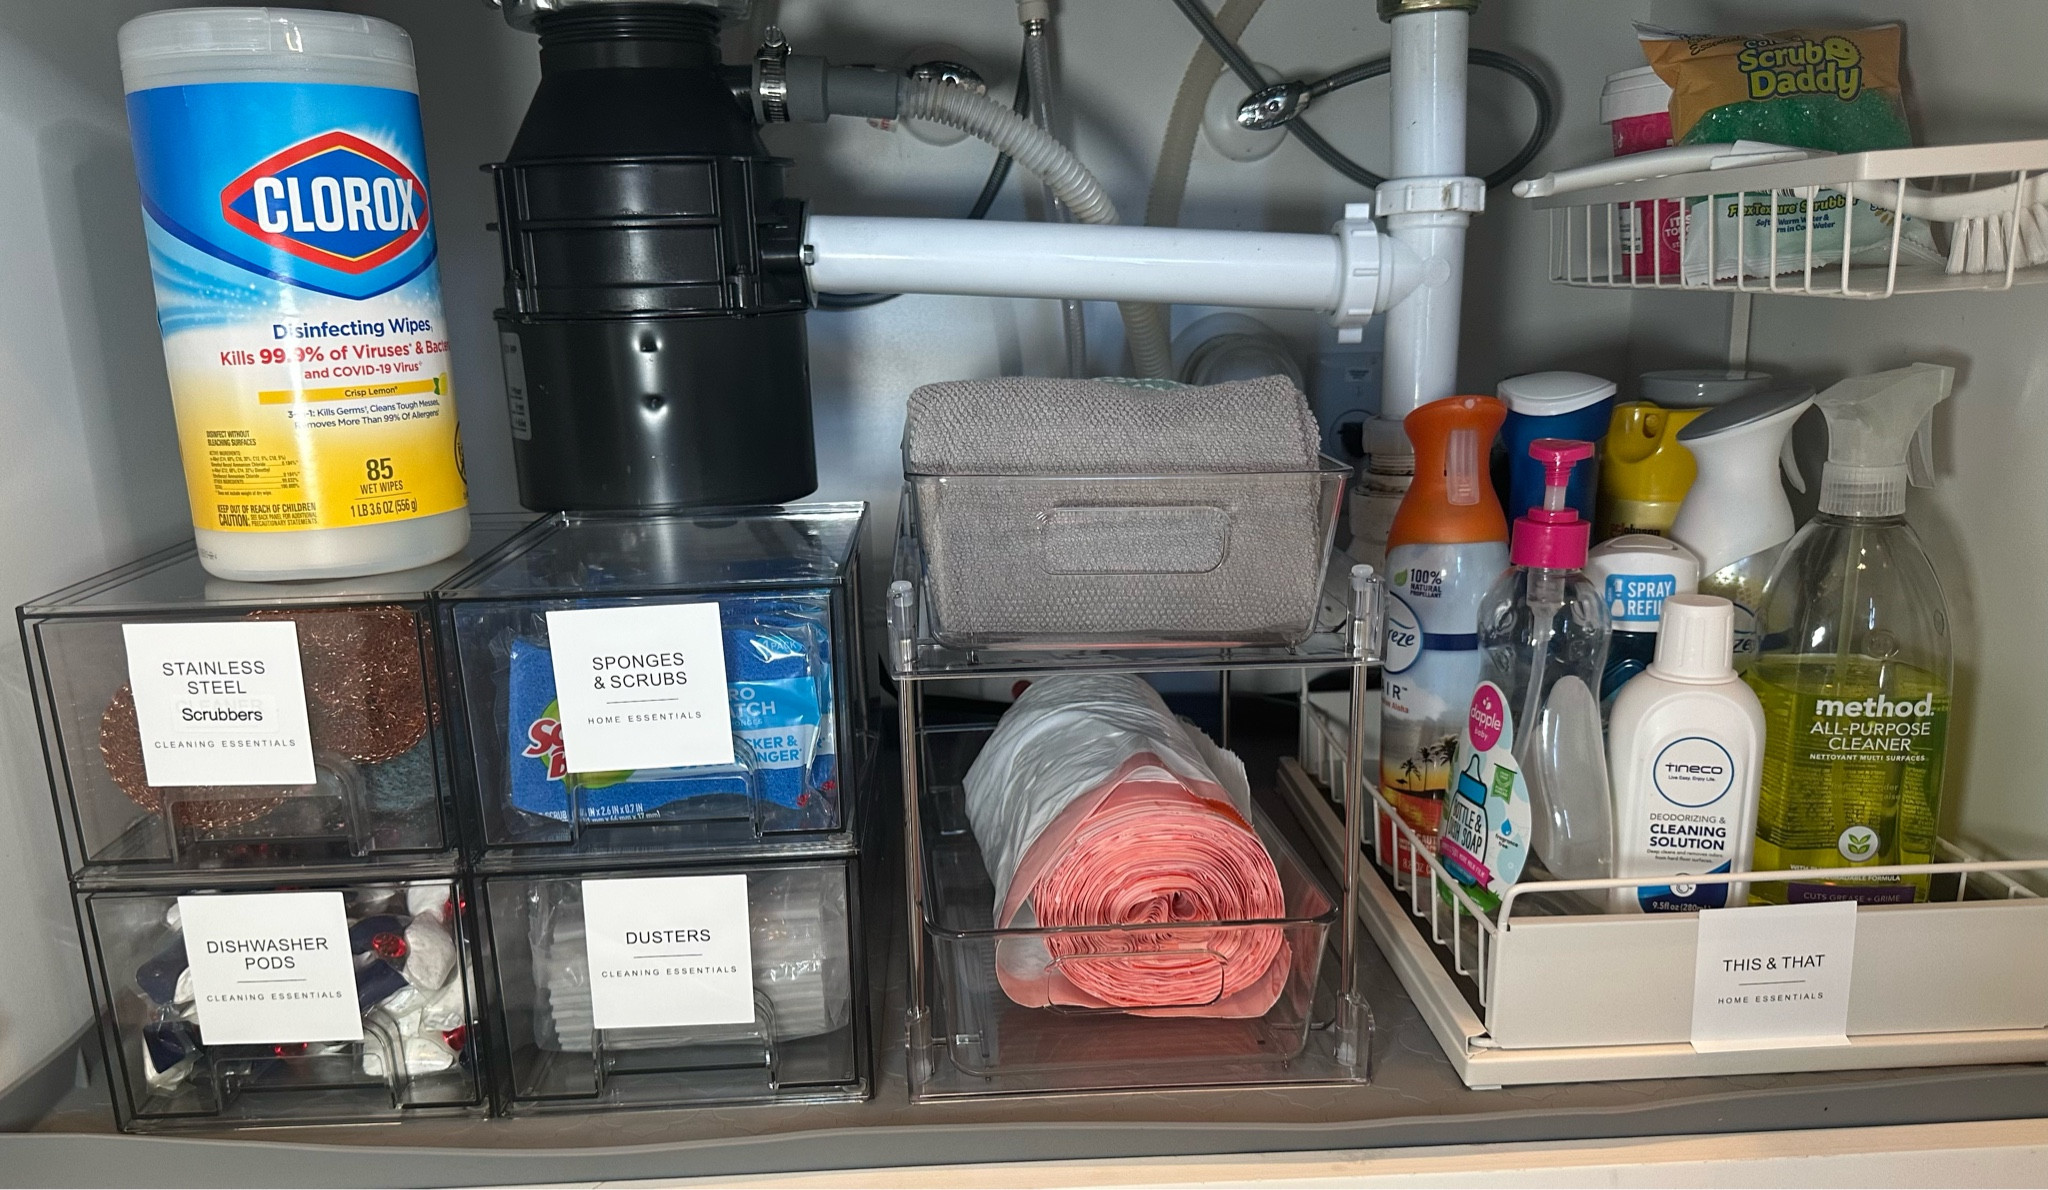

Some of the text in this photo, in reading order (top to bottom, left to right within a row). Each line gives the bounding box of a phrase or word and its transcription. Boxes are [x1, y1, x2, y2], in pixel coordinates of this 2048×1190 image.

[1738, 41, 1824, 73] Scrub
[1748, 62, 1861, 100] Daddy
[253, 176, 419, 234] CLOROX
[1728, 202, 1796, 218] FexTexure
[1801, 215, 1822, 224] Wter
[1823, 213, 1829, 221] &
[220, 350, 255, 366] Kills
[260, 346, 324, 364] 99.9%
[330, 345, 348, 360] of
[415, 341, 424, 354] &
[304, 367, 329, 379] and
[333, 363, 391, 377] COVID-19
[344, 388, 366, 397] Crisp
[288, 409, 315, 418] 3--1:
[317, 408, 335, 417] Kills
[370, 404, 396, 413] Cleans
[396, 401, 418, 411] Tough
[338, 418, 360, 426] More
[362, 416, 382, 424] Than
[384, 414, 400, 422] 99%
[402, 412, 410, 420] Of
[366, 457, 393, 481] 85
[360, 480, 403, 494] WET WIPES
[217, 502, 316, 513] KEEP OUT OF REACH OF CHILDREN
[350, 497, 418, 517] 1 LB 3.6 OZ (556 g)
[1410, 568, 1442, 585] 100%
[1410, 583, 1442, 593] NATURAL
[1627, 581, 1672, 598] SPRAY
[1388, 629, 1415, 647] reze
[162, 660, 266, 676] STAINLESS
[592, 652, 685, 671] SPONGES
[187, 680, 247, 695] STEEL
[593, 671, 688, 690] & SCRUBS
[728, 687, 756, 701] RO
[182, 707, 263, 721] Scrubbers
[587, 711, 702, 725] HOME ESSENTIALS
[1470, 703, 1501, 730] dapple
[1474, 726, 1488, 741] baby
[1810, 721, 1931, 737] ALL-PURPOSE
[154, 738, 297, 749] CLEANING ESSENTIALS
[786, 735, 798, 747] &
[1828, 737, 1911, 751] CLEANER
[757, 749, 802, 763] NGER
[1809, 753, 1857, 761] NETTOYANT
[1886, 754, 1926, 762] SURFACES
[1665, 762, 1723, 775] tineco
[601, 806, 611, 816] 2.6
[611, 805, 619, 815] IN
[625, 804, 634, 814] 0.7
[635, 803, 643, 813] IN
[1474, 814, 1482, 834] &
[1650, 812, 1726, 825] DEODORIZING &
[1650, 823, 1726, 838] CLEANING
[1461, 828, 1483, 854] SOAP
[1649, 836, 1725, 851] SOLUTION
[1803, 892, 1827, 901] CUTS
[1873, 894, 1900, 903] GRIME
[625, 928, 711, 945] DUSTERS
[206, 936, 329, 954] DISHWASHER
[244, 956, 296, 970] PODS
[1723, 954, 1826, 972] THIS & THAT
[601, 964, 738, 978] CLEANING ESSENTIALS
[206, 990, 343, 1002] CLEANING ESSENTIALS
[1717, 991, 1824, 1005] HOME ESSENTIALS
